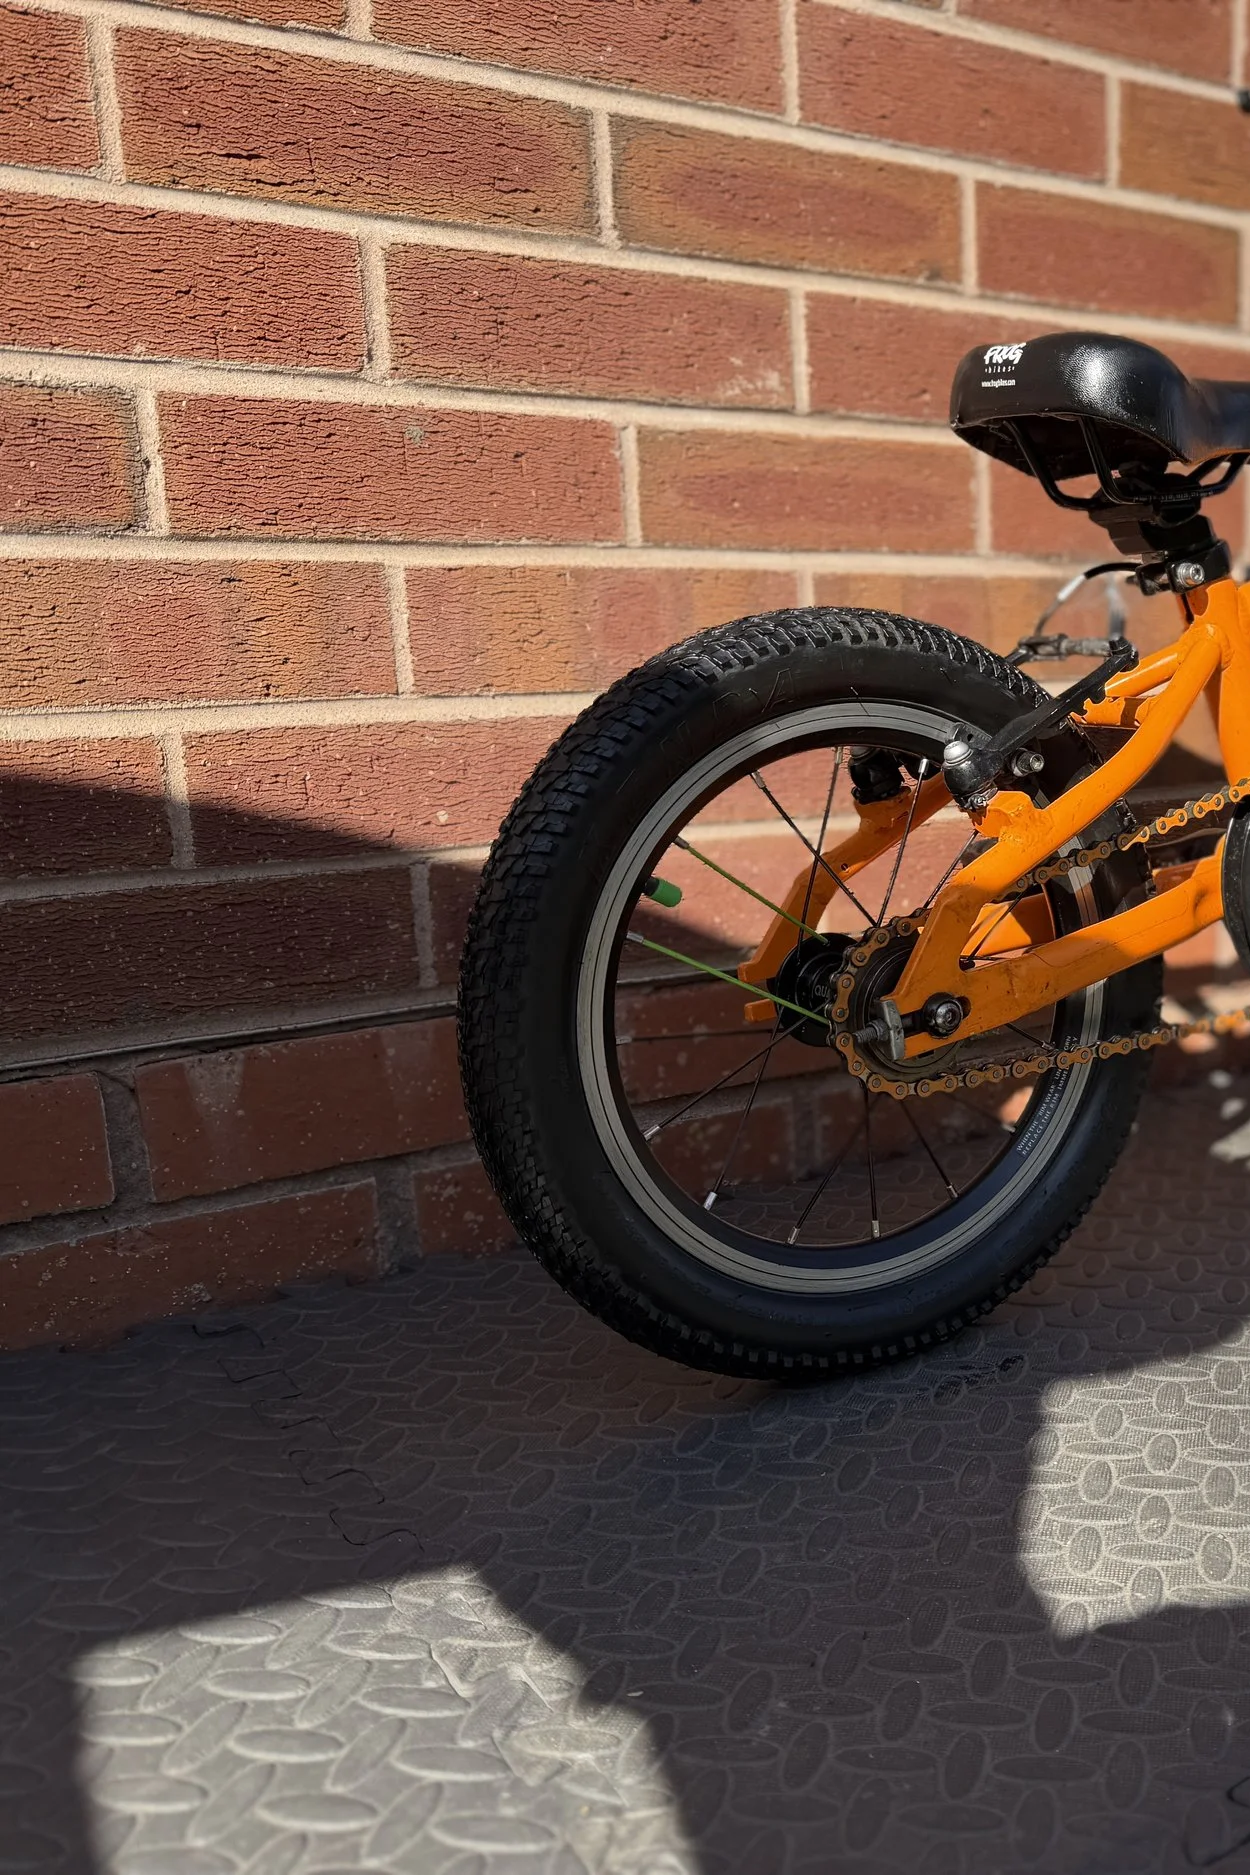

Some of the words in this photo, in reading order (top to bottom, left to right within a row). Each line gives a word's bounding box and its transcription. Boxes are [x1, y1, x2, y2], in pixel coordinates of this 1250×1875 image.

[984, 342, 1026, 364] FROG
[1022, 1128, 1042, 1156] REPLACE
[1042, 1110, 1051, 1123] THE
[1050, 1093, 1060, 1108] RIM
[1017, 1131, 1031, 1151] WHEN
